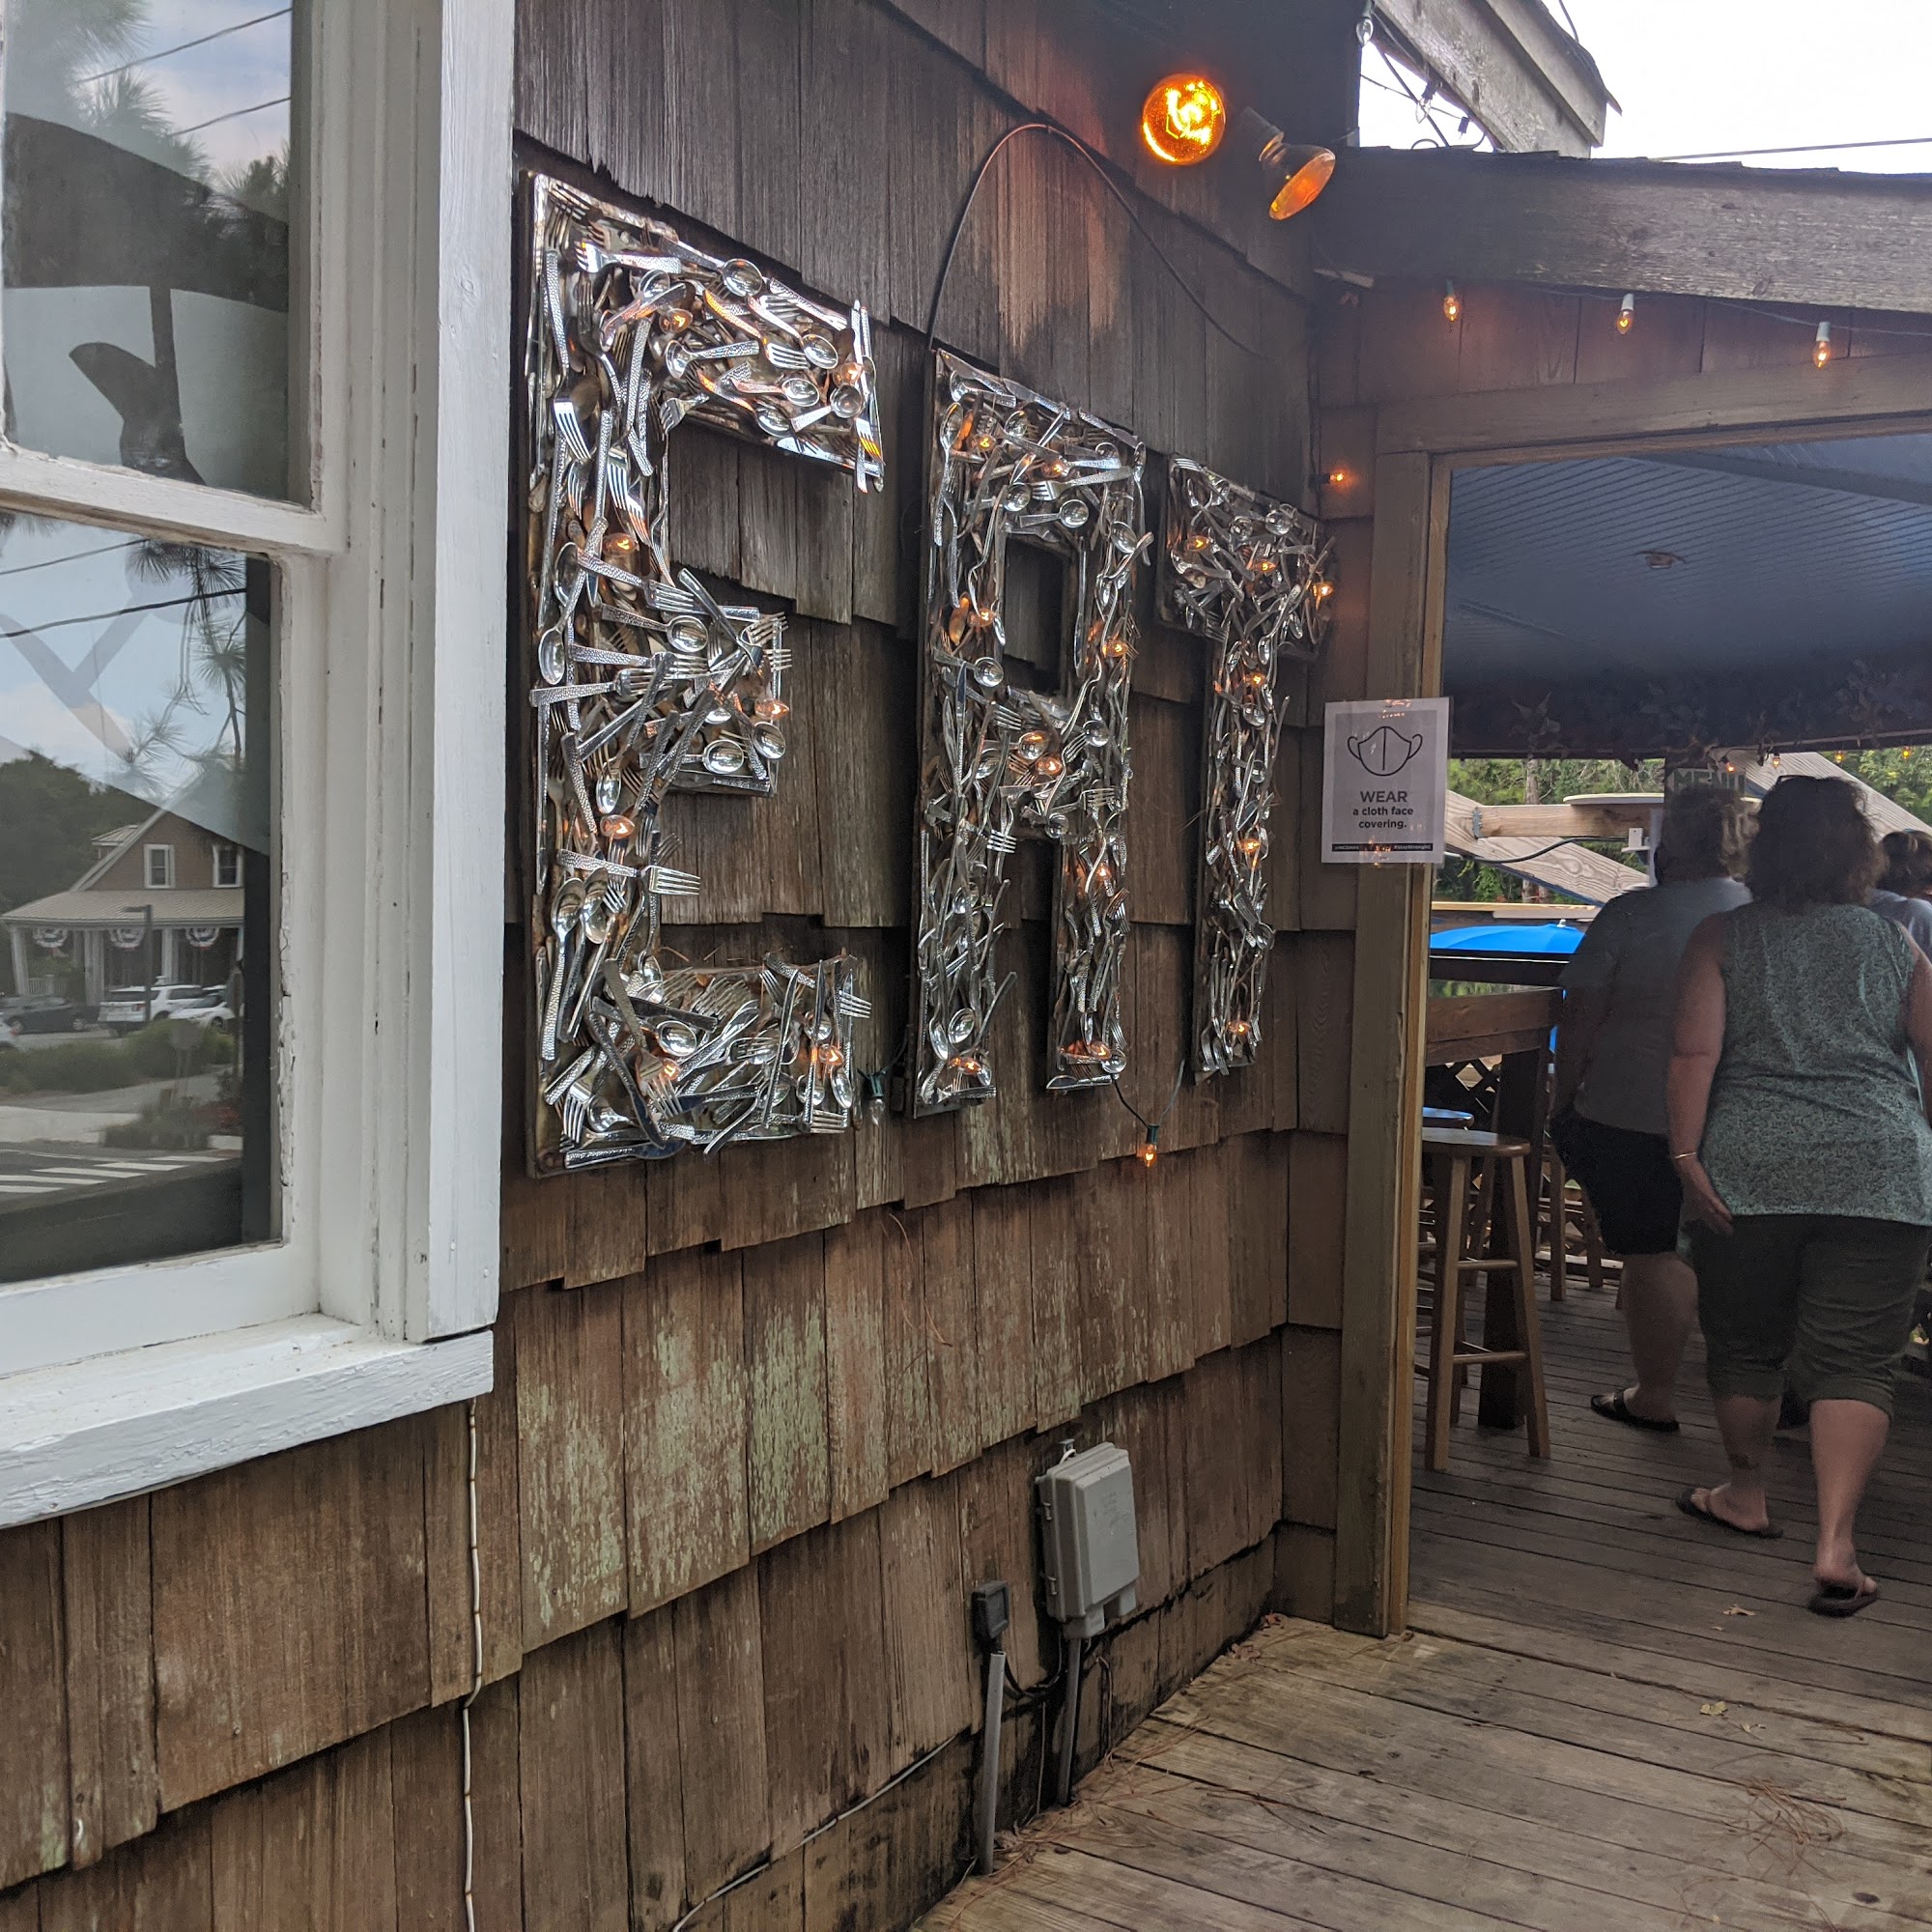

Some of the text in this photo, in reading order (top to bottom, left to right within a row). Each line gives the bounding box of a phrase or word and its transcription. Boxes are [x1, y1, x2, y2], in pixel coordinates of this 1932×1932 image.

[524, 171, 1335, 1178] EAT
[1360, 790, 1407, 803] WEAR
[1352, 807, 1413, 816] a cloth face
[1358, 819, 1407, 829] covering.
